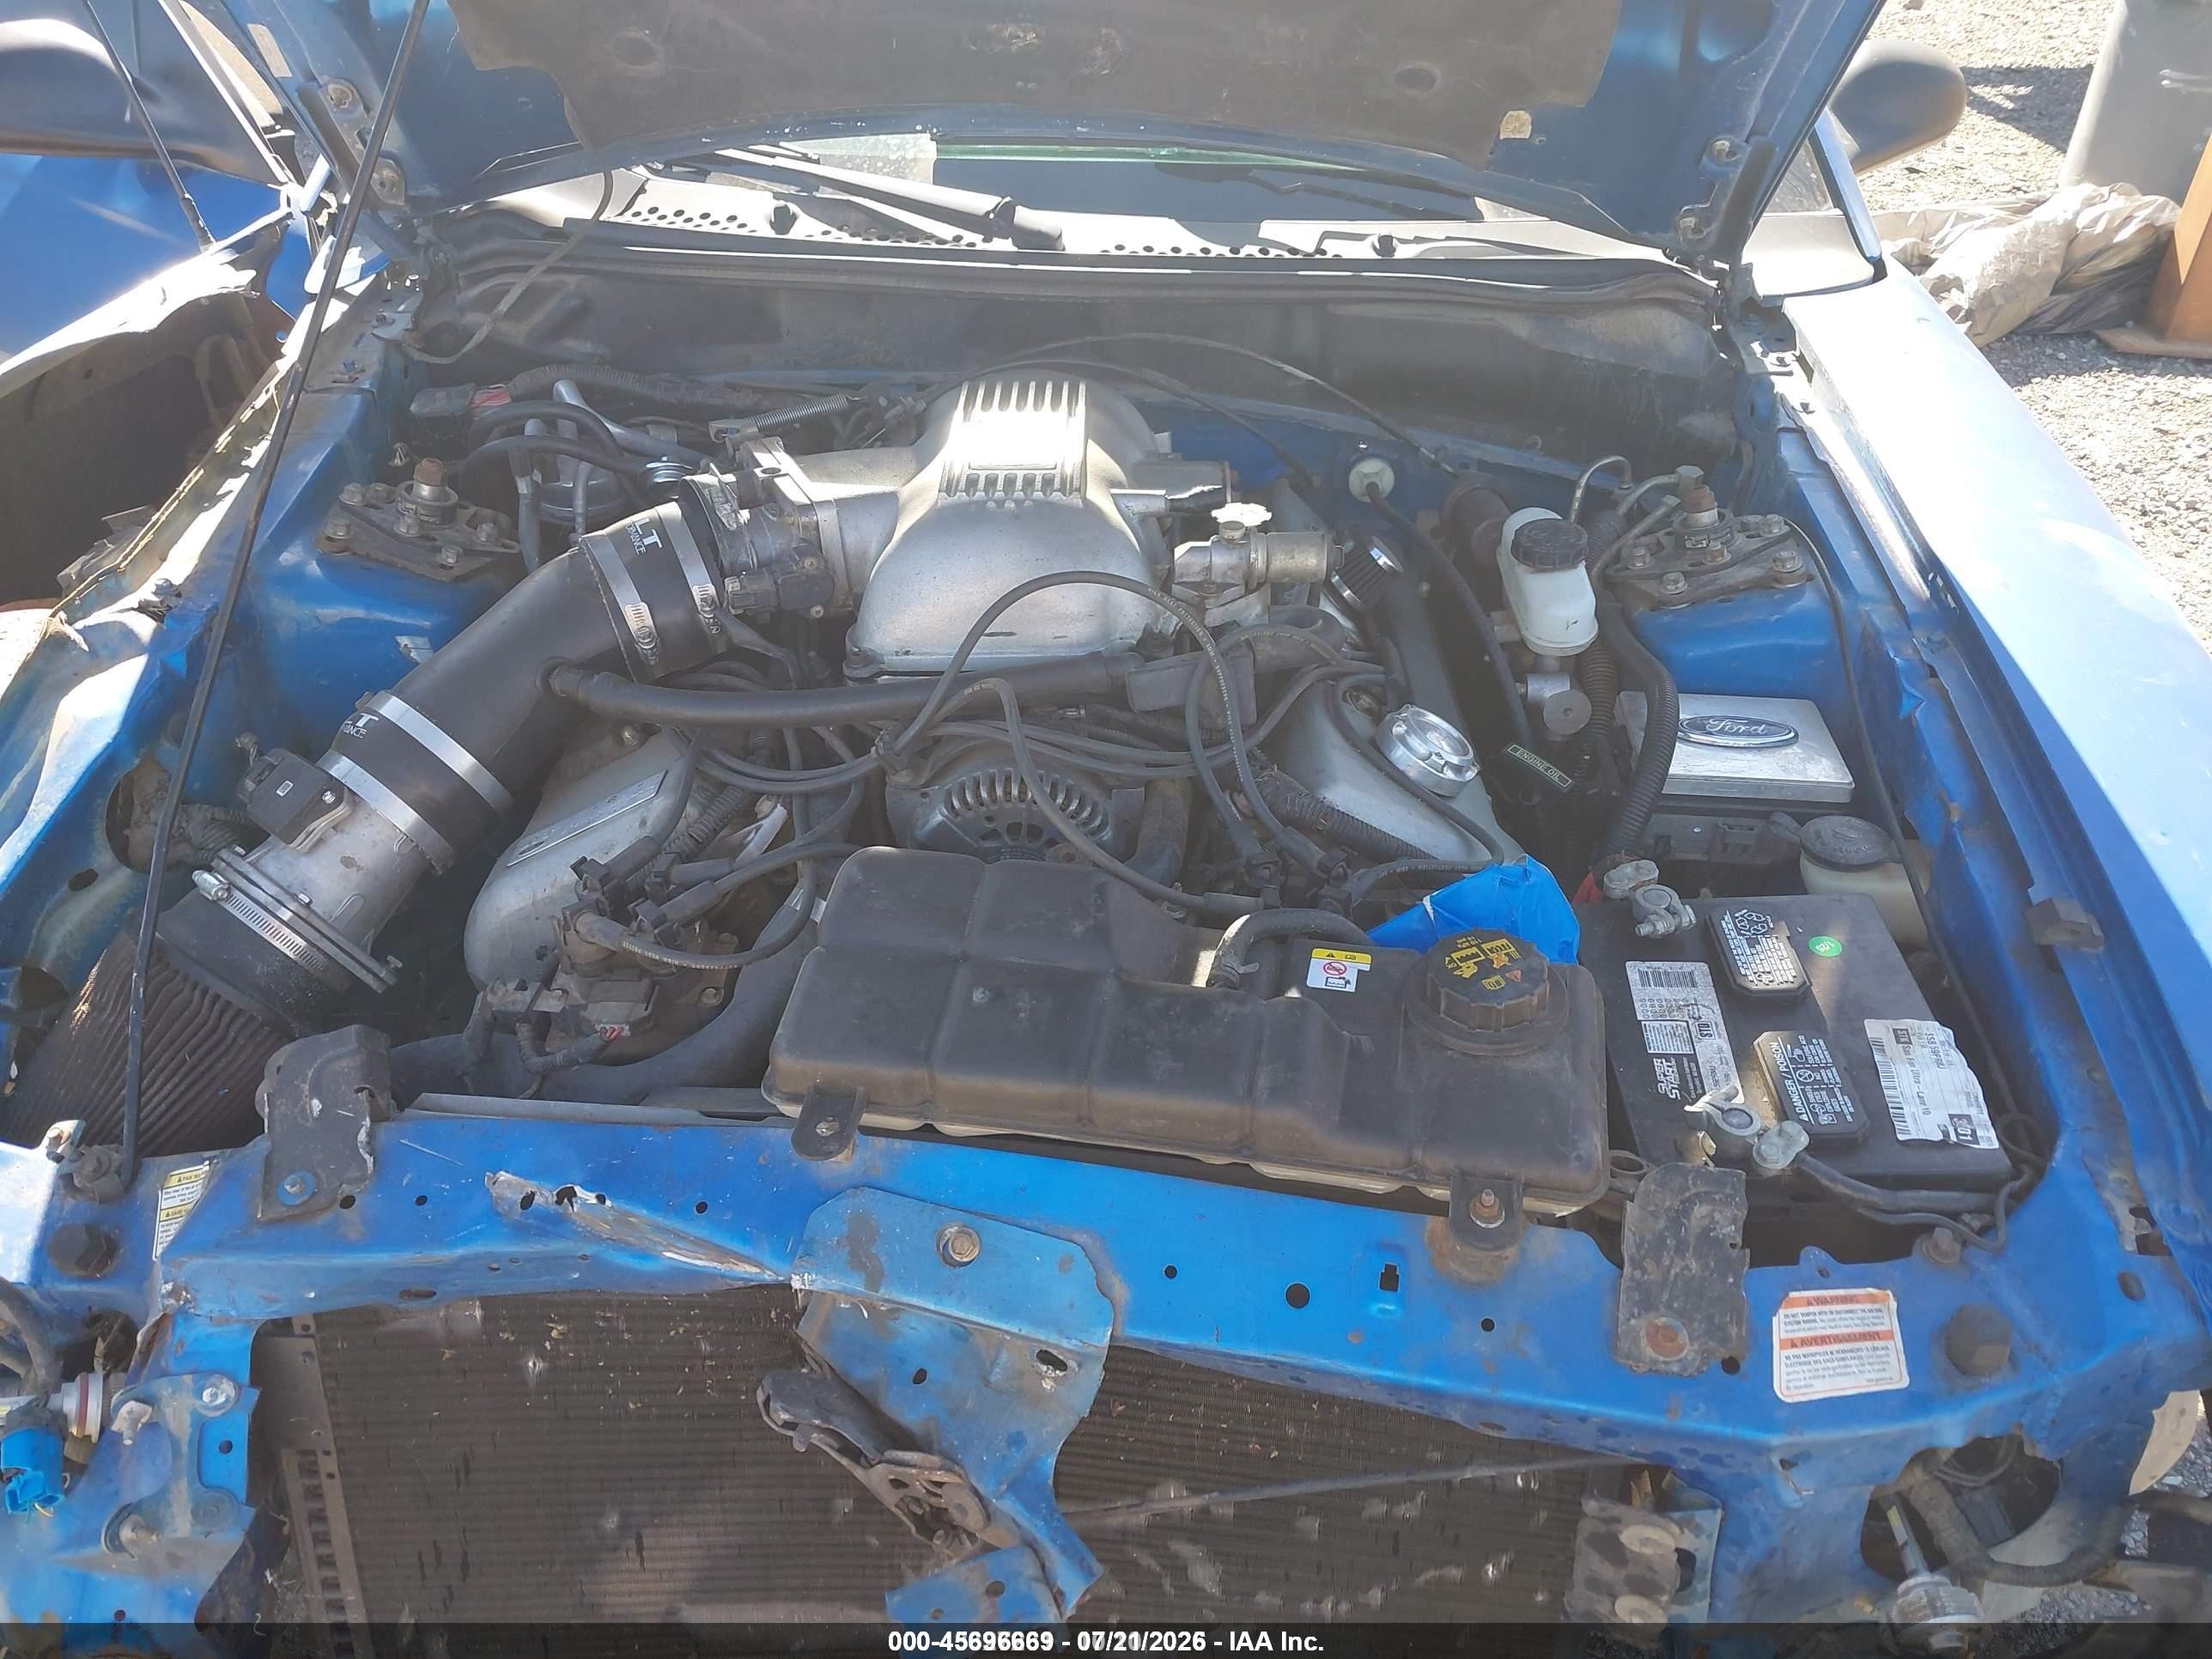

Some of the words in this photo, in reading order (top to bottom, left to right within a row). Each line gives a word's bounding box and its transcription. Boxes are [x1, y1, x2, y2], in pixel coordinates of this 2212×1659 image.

[1706, 718, 1767, 734] Ford
[1516, 750, 1547, 770] ENGINE
[1547, 769, 1561, 781] OIL
[1696, 1022, 1713, 1037] STD
[1797, 1034, 1807, 1045] ACID
[1769, 1041, 1790, 1072] POISON
[1652, 1056, 1668, 1094] SUPER
[1662, 1056, 1680, 1100] START
[1784, 1078, 1806, 1114] DANGER
[1812, 1294, 1856, 1306] WARNING
[1799, 1330, 1881, 1347] AVERTISSEMENT
